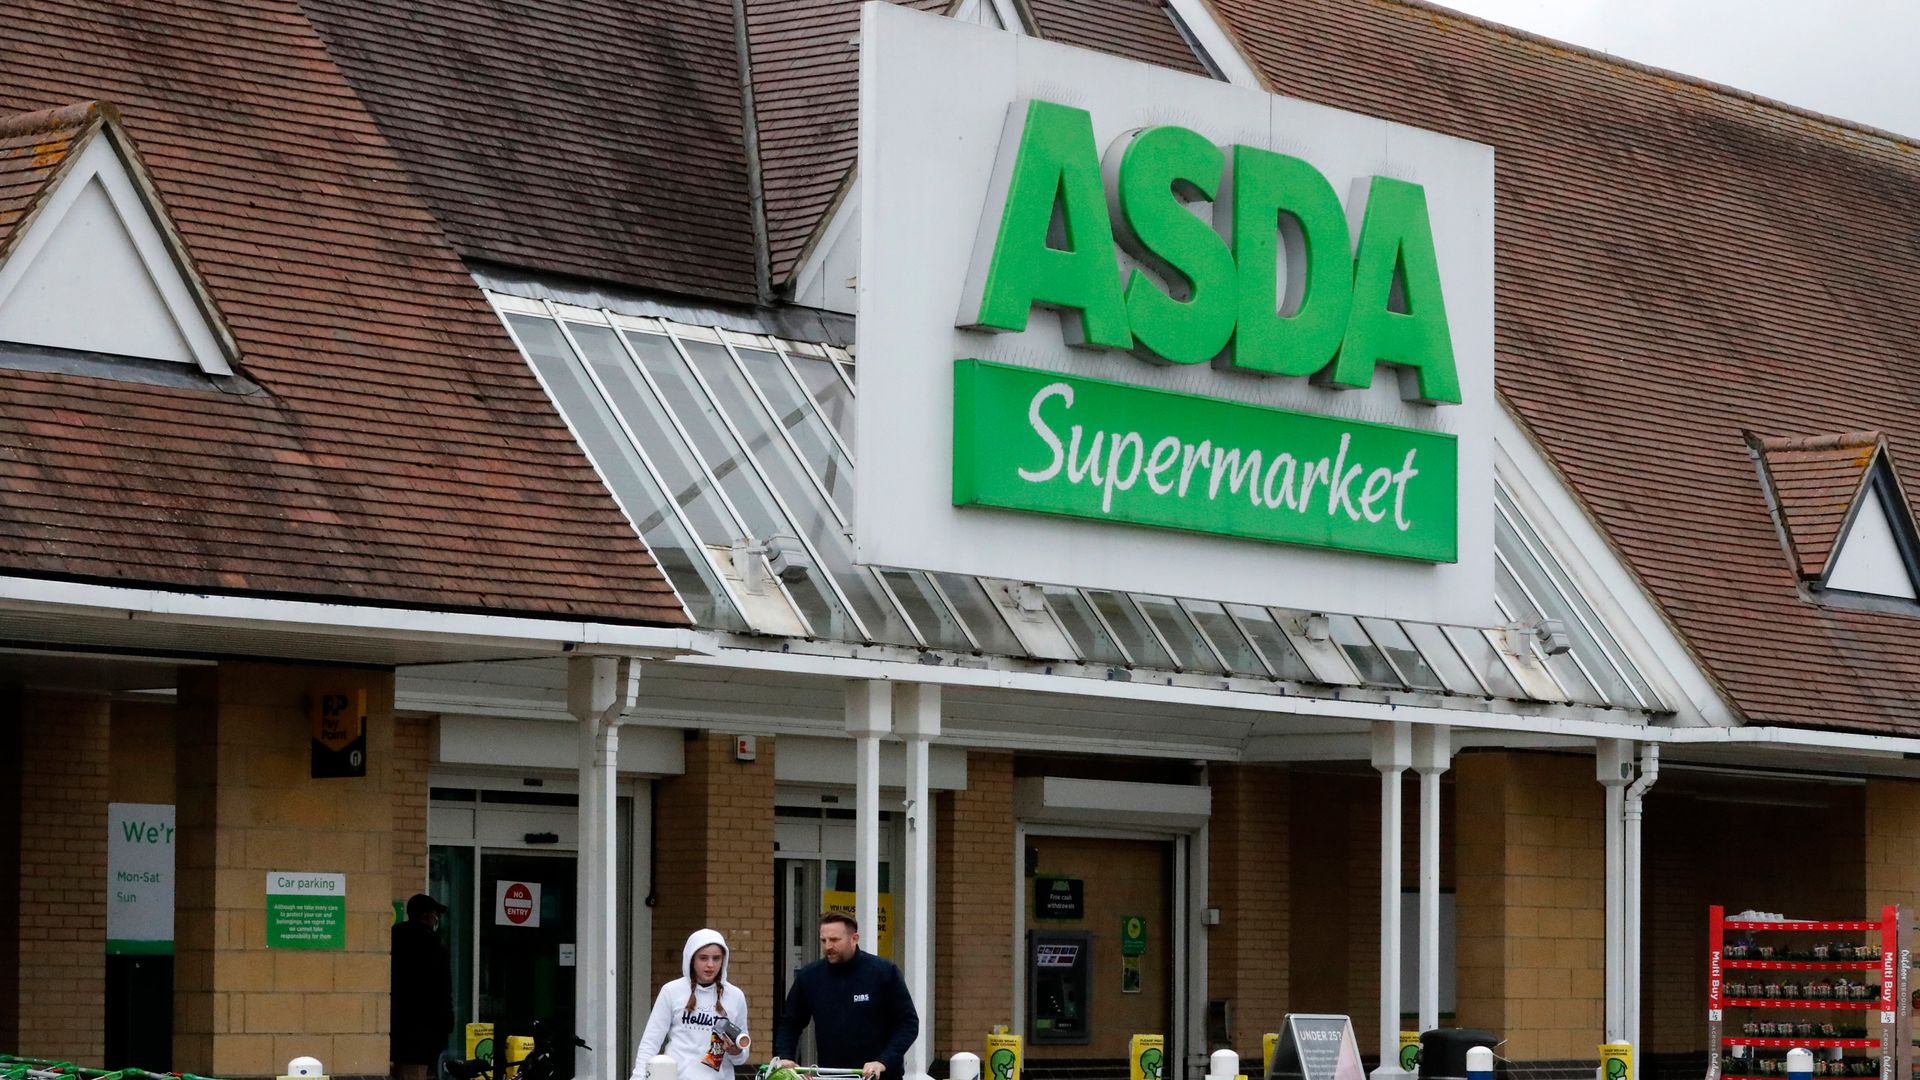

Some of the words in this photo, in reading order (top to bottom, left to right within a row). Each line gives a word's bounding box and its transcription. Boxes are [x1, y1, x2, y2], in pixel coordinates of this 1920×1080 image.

[957, 98, 1463, 405] ASDA
[1018, 382, 1419, 531] Supermarket
[122, 820, 175, 844] We'r
[117, 871, 160, 883] Mon-Sat
[277, 876, 295, 889] Car
[297, 878, 335, 891] parking
[116, 891, 137, 903] Sun
[513, 891, 524, 899] NO
[1049, 893, 1061, 901] Free
[507, 908, 529, 916] ENTRY
[1047, 902, 1075, 910] withdrawals
[1711, 951, 1720, 977] Multi
[1884, 951, 1893, 978] Multi
[1900, 949, 1910, 980] Outdoor
[853, 993, 870, 1001] DIBS
[1710, 979, 1720, 1001] Buy
[1883, 981, 1893, 1002] Buy
[682, 1010, 728, 1027] Hollist
[1299, 1030, 1328, 1041] UNDER
[1328, 1030, 1342, 1041] 25?
